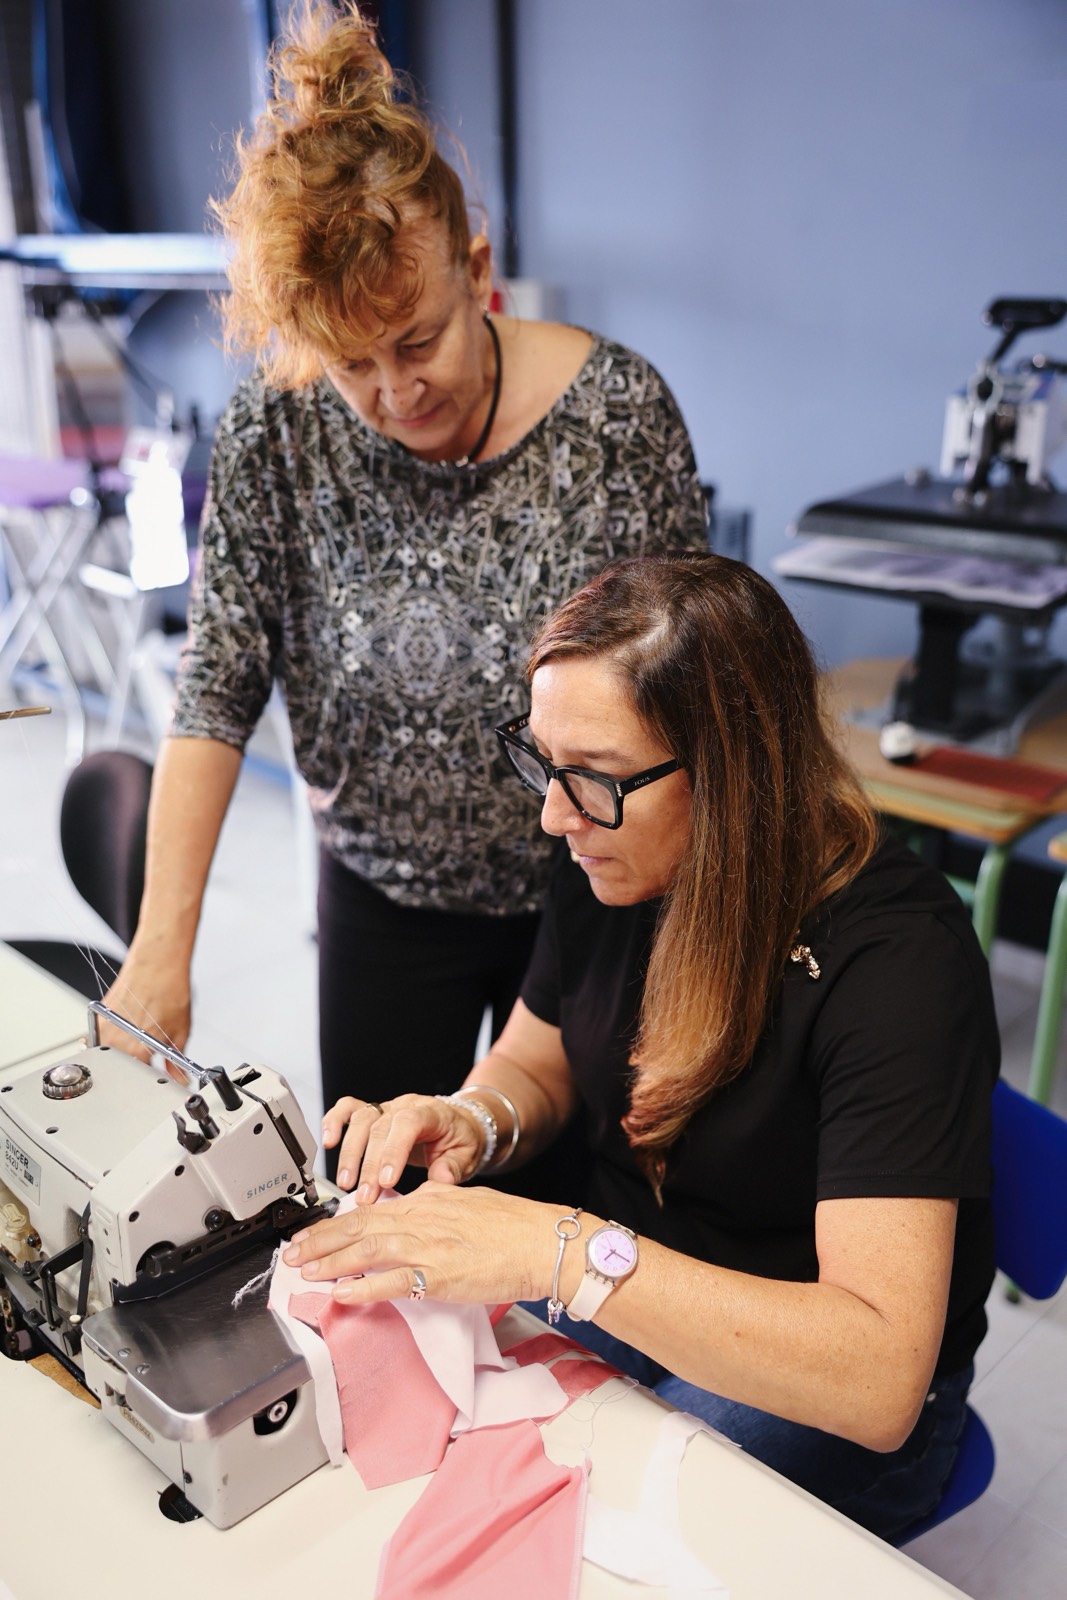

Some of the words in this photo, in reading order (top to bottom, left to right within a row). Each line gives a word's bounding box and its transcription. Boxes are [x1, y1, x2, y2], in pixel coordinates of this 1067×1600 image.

[633, 776, 651, 786] TOUS
[5, 1139, 29, 1169] SINGER
[246, 1173, 288, 1199] SINGER
